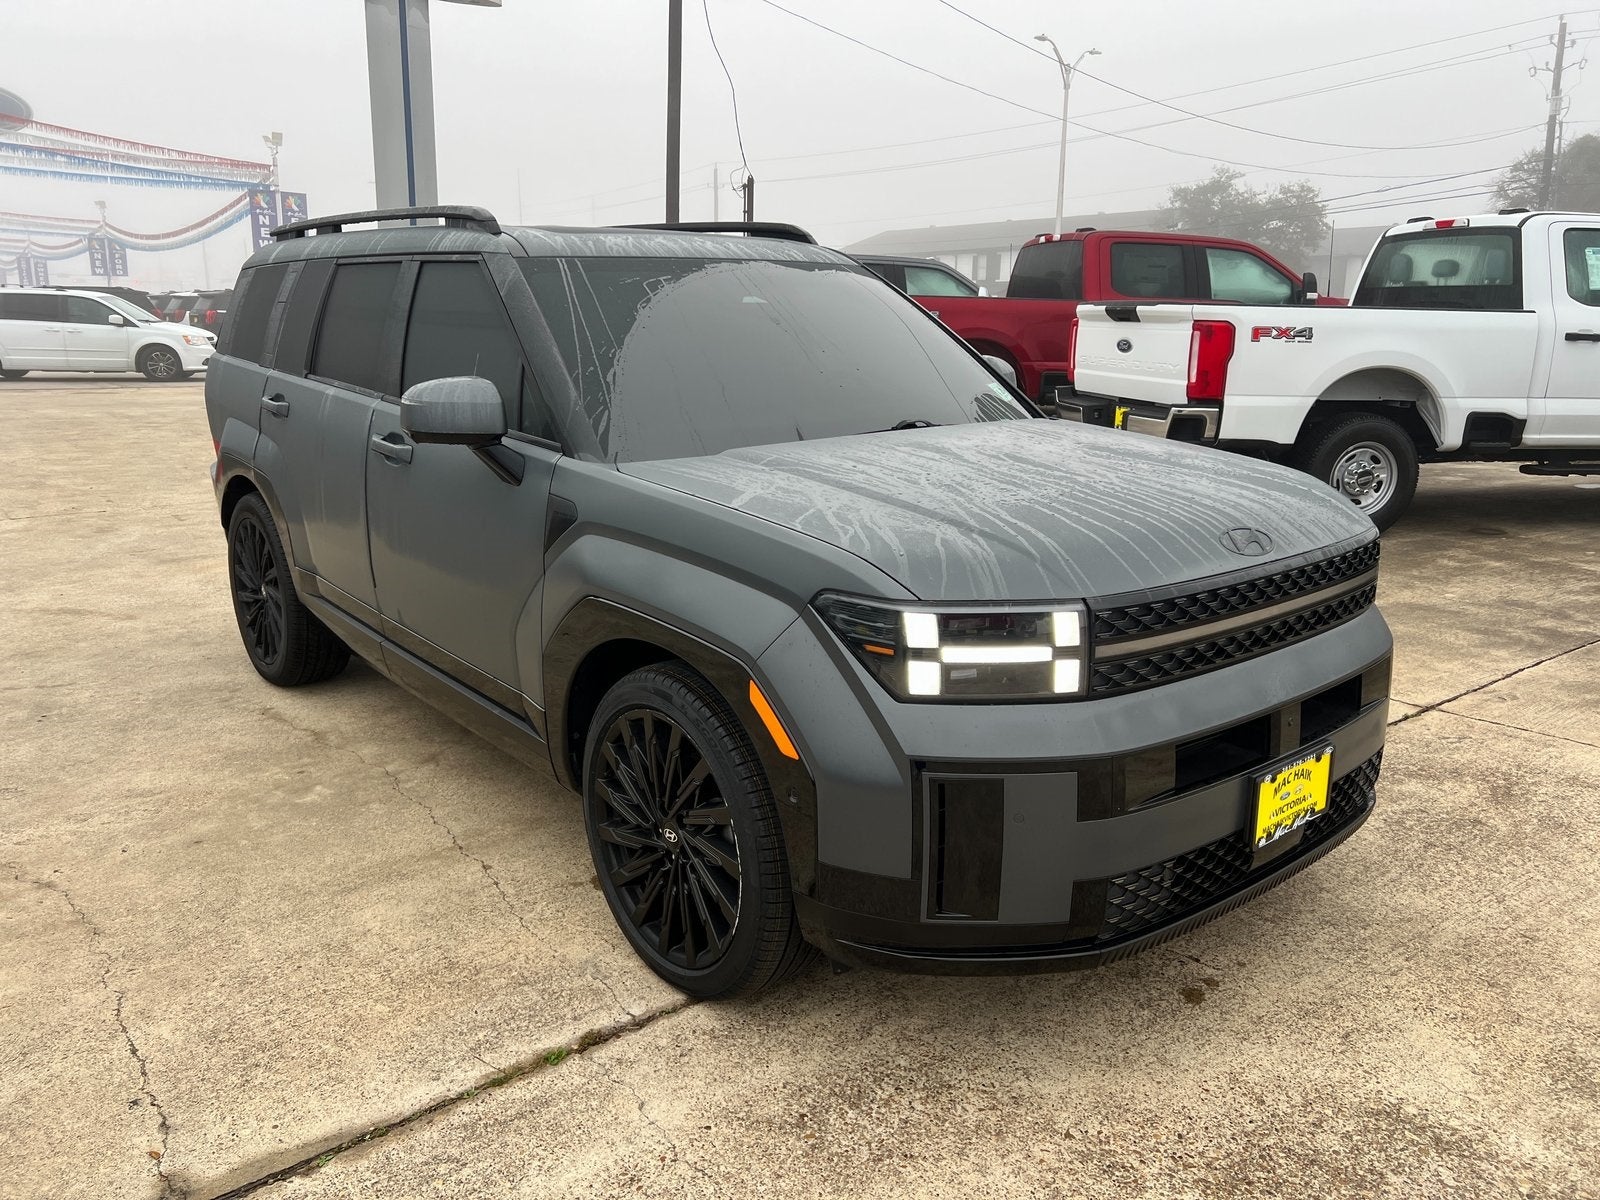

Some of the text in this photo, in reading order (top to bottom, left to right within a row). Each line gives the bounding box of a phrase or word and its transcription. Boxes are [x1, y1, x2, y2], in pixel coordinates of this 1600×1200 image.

[258, 214, 273, 248] NEW
[93, 252, 104, 274] NEW
[114, 253, 123, 275] FORD
[1251, 325, 1313, 342] FX4
[1079, 355, 1181, 374] SUPER DUTY
[1273, 772, 1293, 799] MAC
[1293, 768, 1313, 782] HAIK
